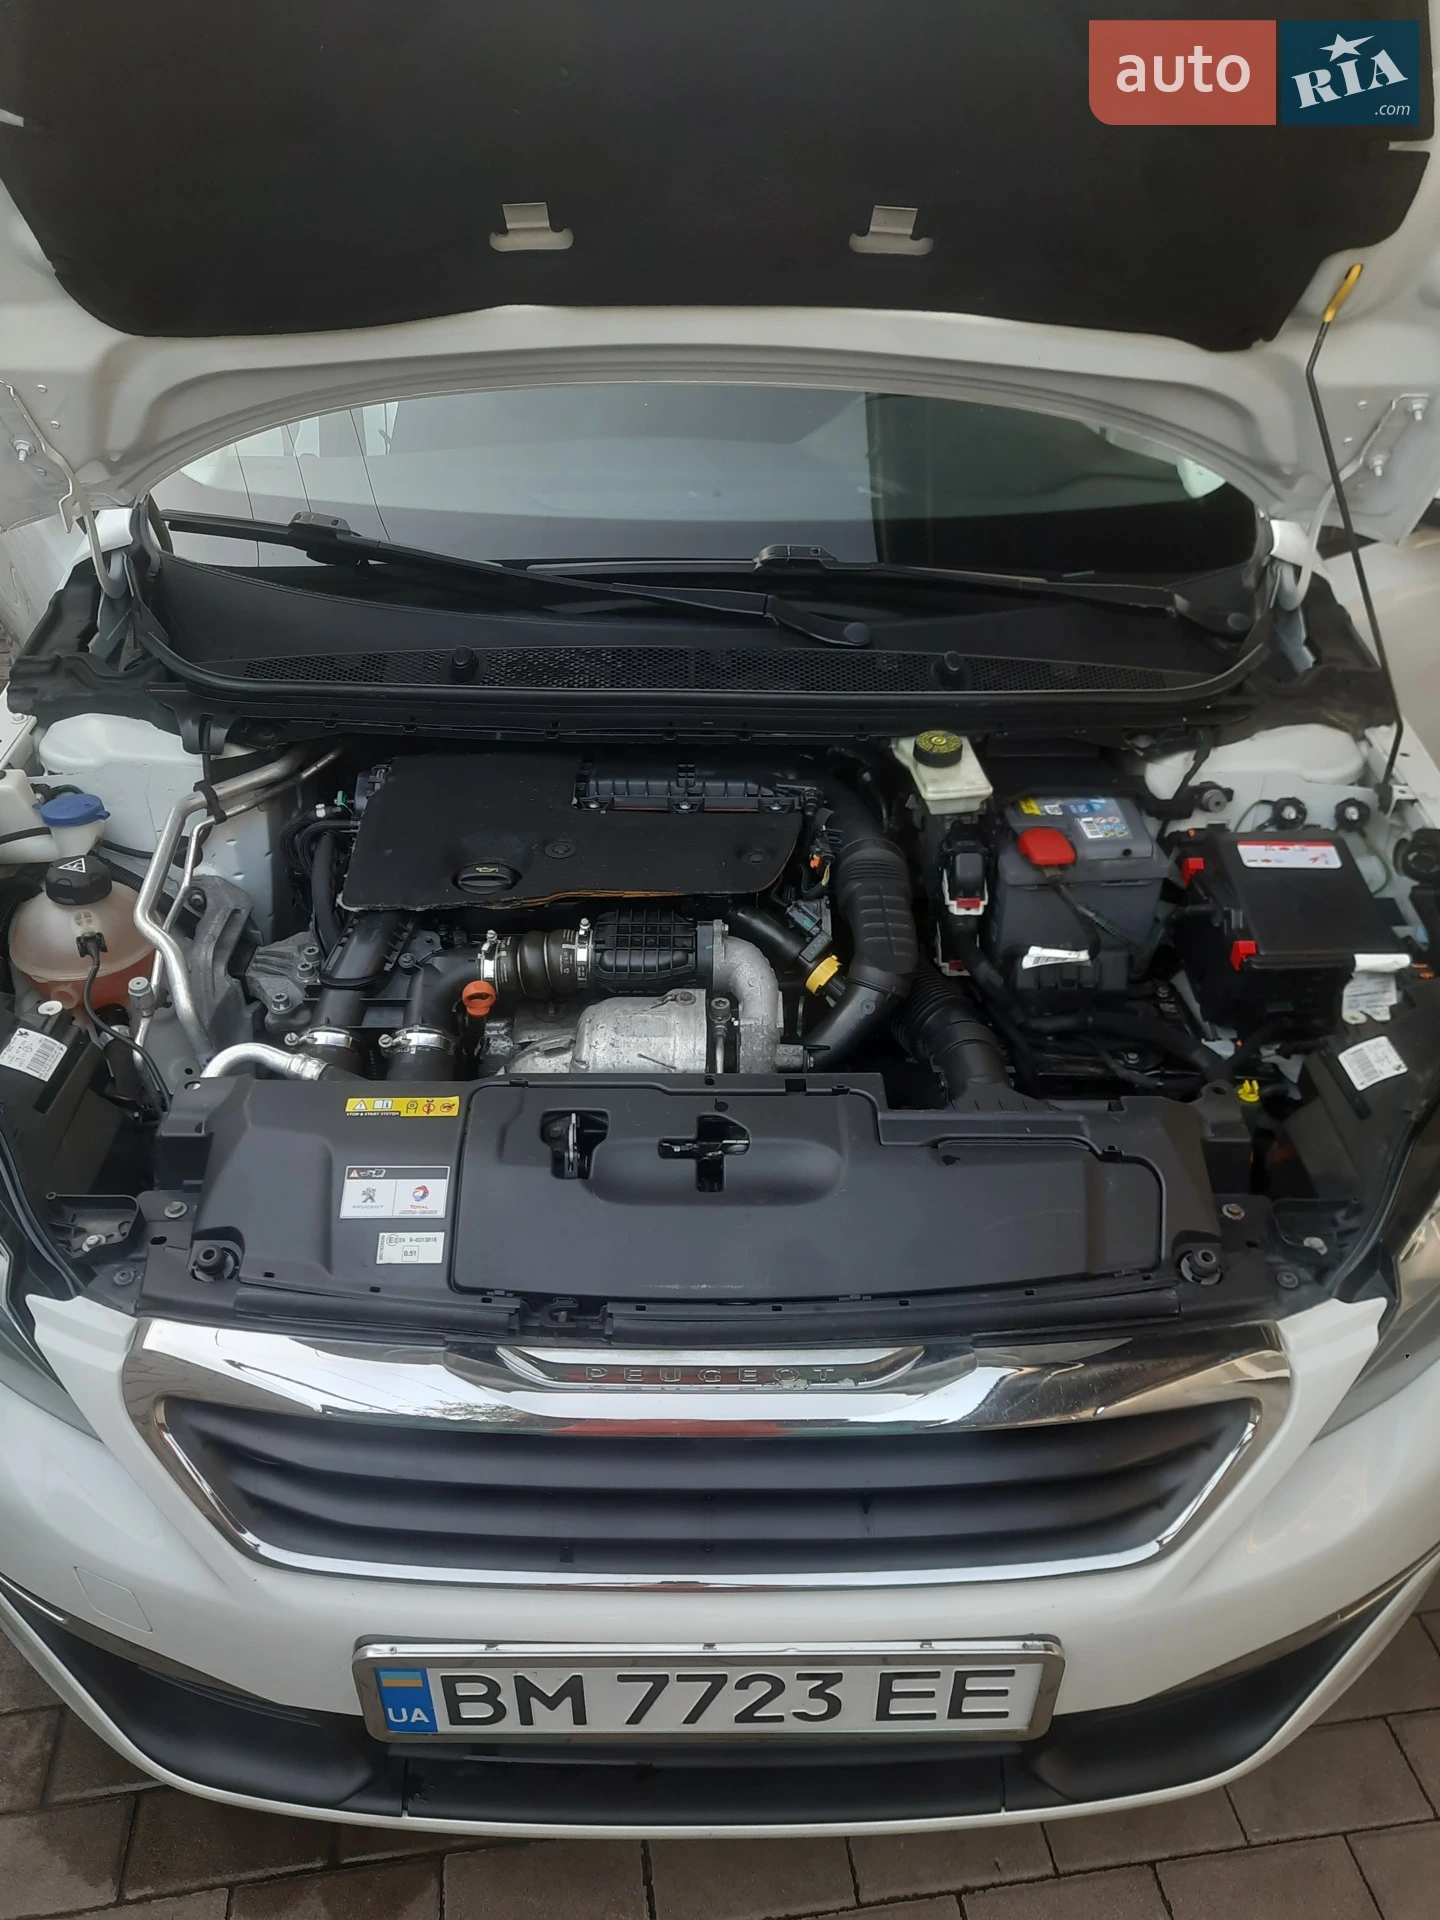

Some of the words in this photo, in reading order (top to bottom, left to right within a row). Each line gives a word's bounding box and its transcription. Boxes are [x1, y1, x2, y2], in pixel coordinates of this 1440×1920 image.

[585, 1366, 835, 1383] PEUGEOT
[440, 1673, 588, 1726] BM
[616, 1672, 843, 1725] 7723
[875, 1669, 1015, 1721] EE
[388, 1707, 430, 1723] UA
